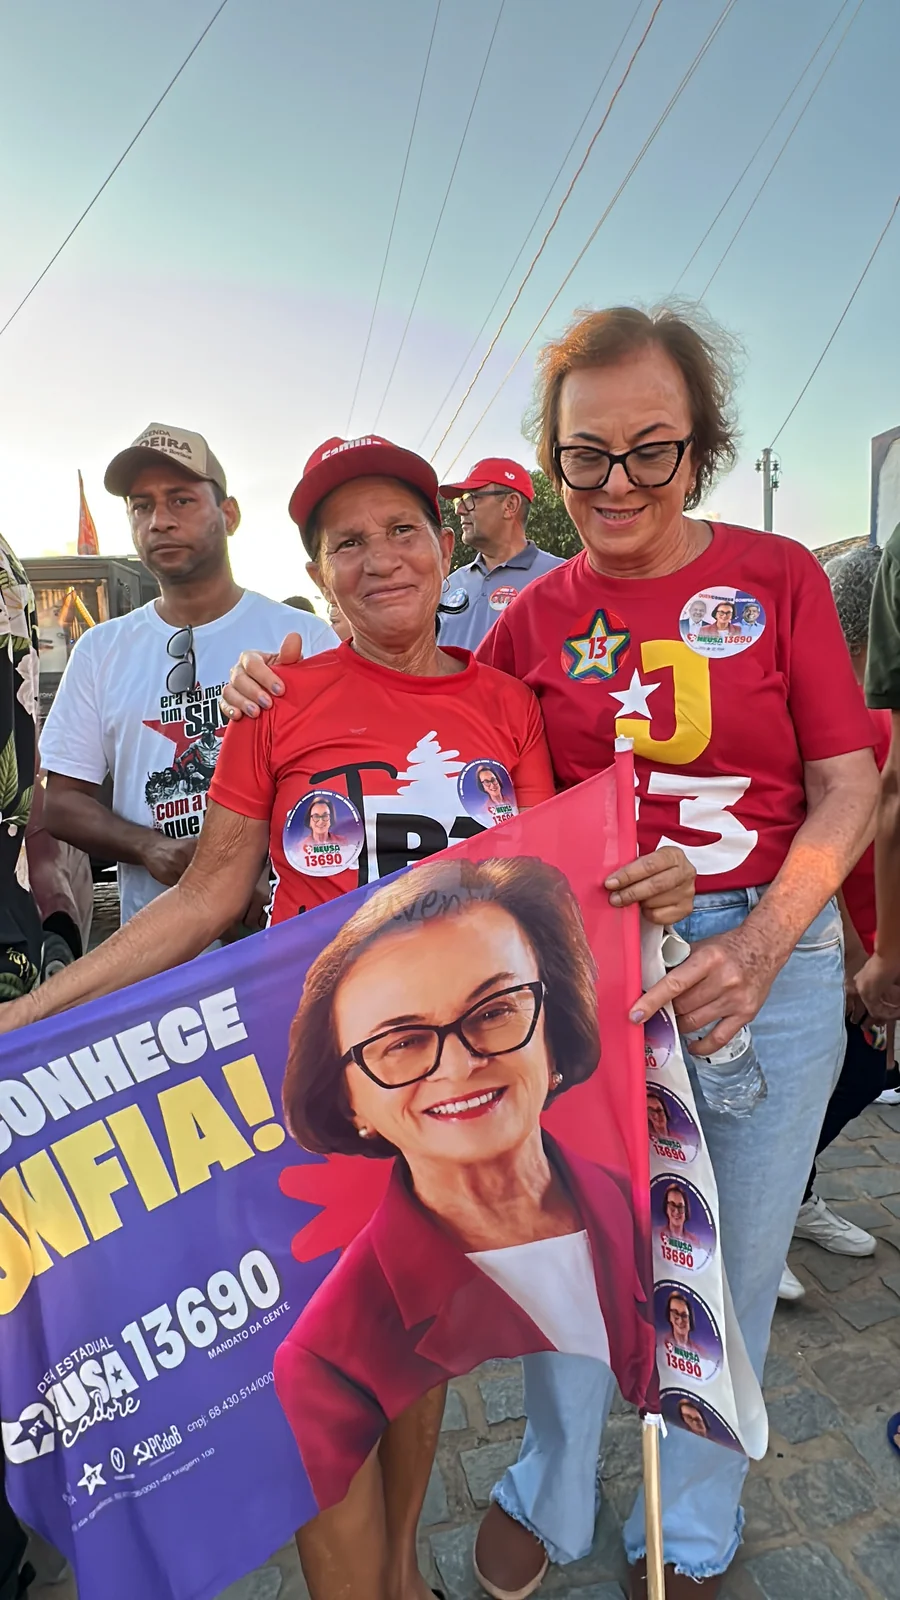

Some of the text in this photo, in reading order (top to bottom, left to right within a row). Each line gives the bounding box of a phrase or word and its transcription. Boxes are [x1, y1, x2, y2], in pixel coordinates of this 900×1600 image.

[588, 636, 607, 660] 13
[724, 635, 753, 644] 13690
[160, 692, 183, 708] era
[615, 639, 713, 765] J
[161, 707, 182, 723] um
[156, 798, 189, 821] com
[192, 795, 202, 811] a
[313, 844, 340, 853] NEUSA
[304, 854, 343, 867] 13690
[0, 987, 248, 1152] ONHECE
[653, 1144, 686, 1162] 13690
[661, 1245, 694, 1268] 13690
[121, 1250, 280, 1381] 13690
[207, 1301, 291, 1359] MANDATO DA GENTE
[55, 1336, 114, 1377] ESTADUAL
[665, 1352, 702, 1378] 13690
[28, 1420, 45, 1437] PT
[148, 1425, 183, 1457] PCdoB
[86, 1470, 99, 1484] PT
